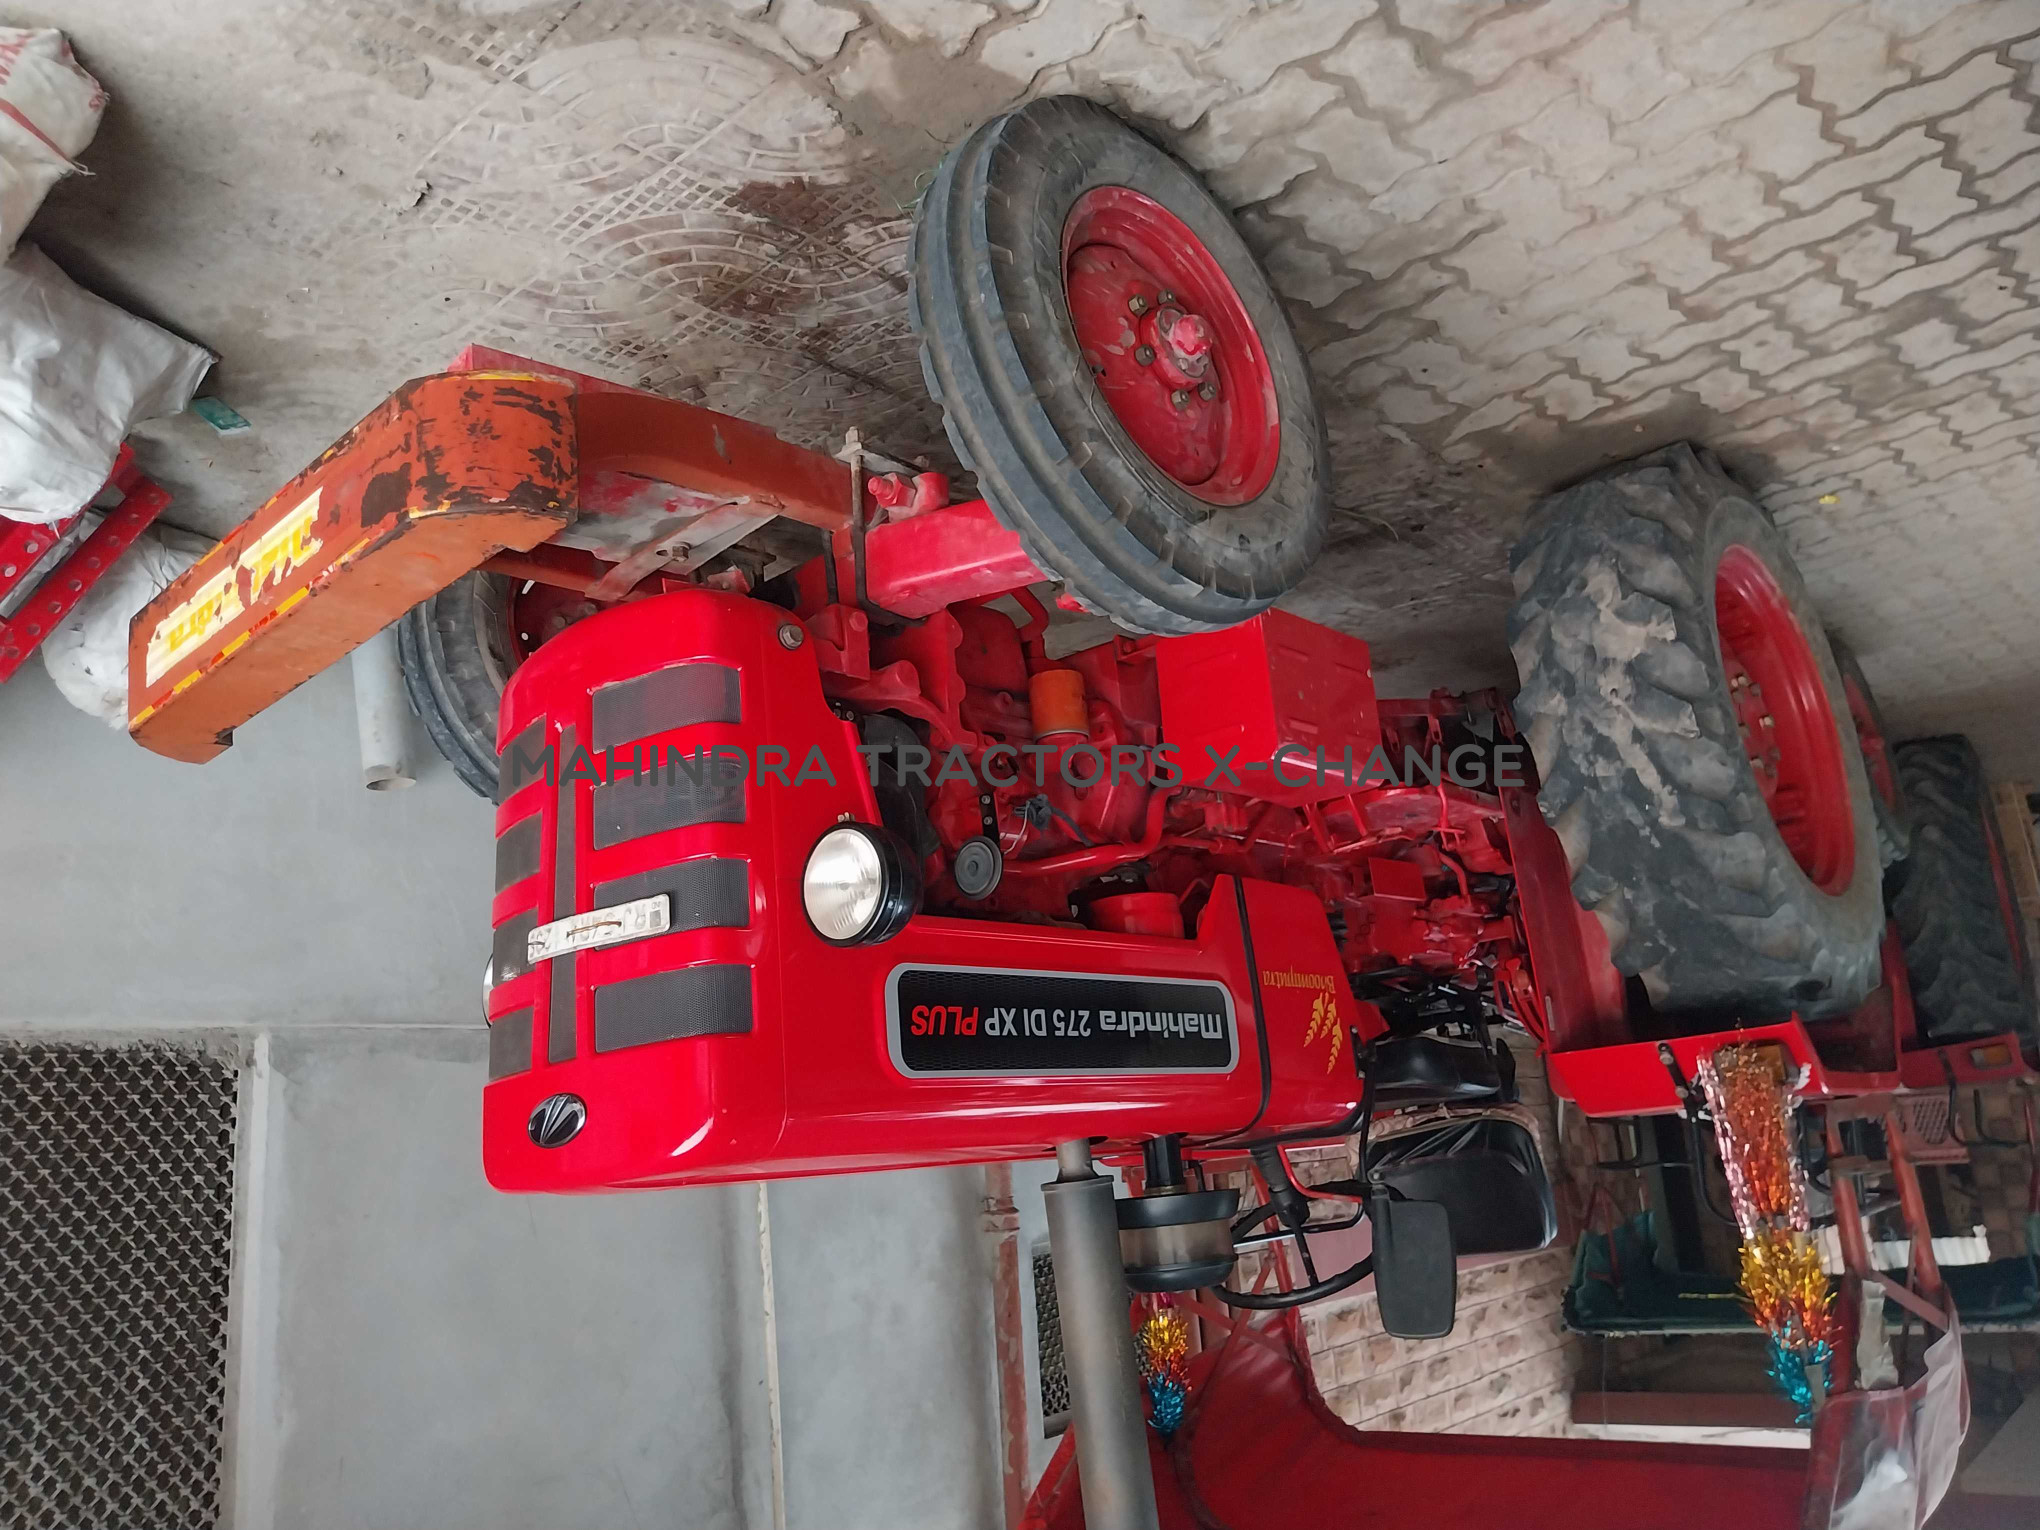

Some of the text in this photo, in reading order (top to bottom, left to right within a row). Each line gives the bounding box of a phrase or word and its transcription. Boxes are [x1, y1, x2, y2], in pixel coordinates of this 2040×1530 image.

[910, 1004, 1223, 1040] Mahindra 275 DI XP PLUS
